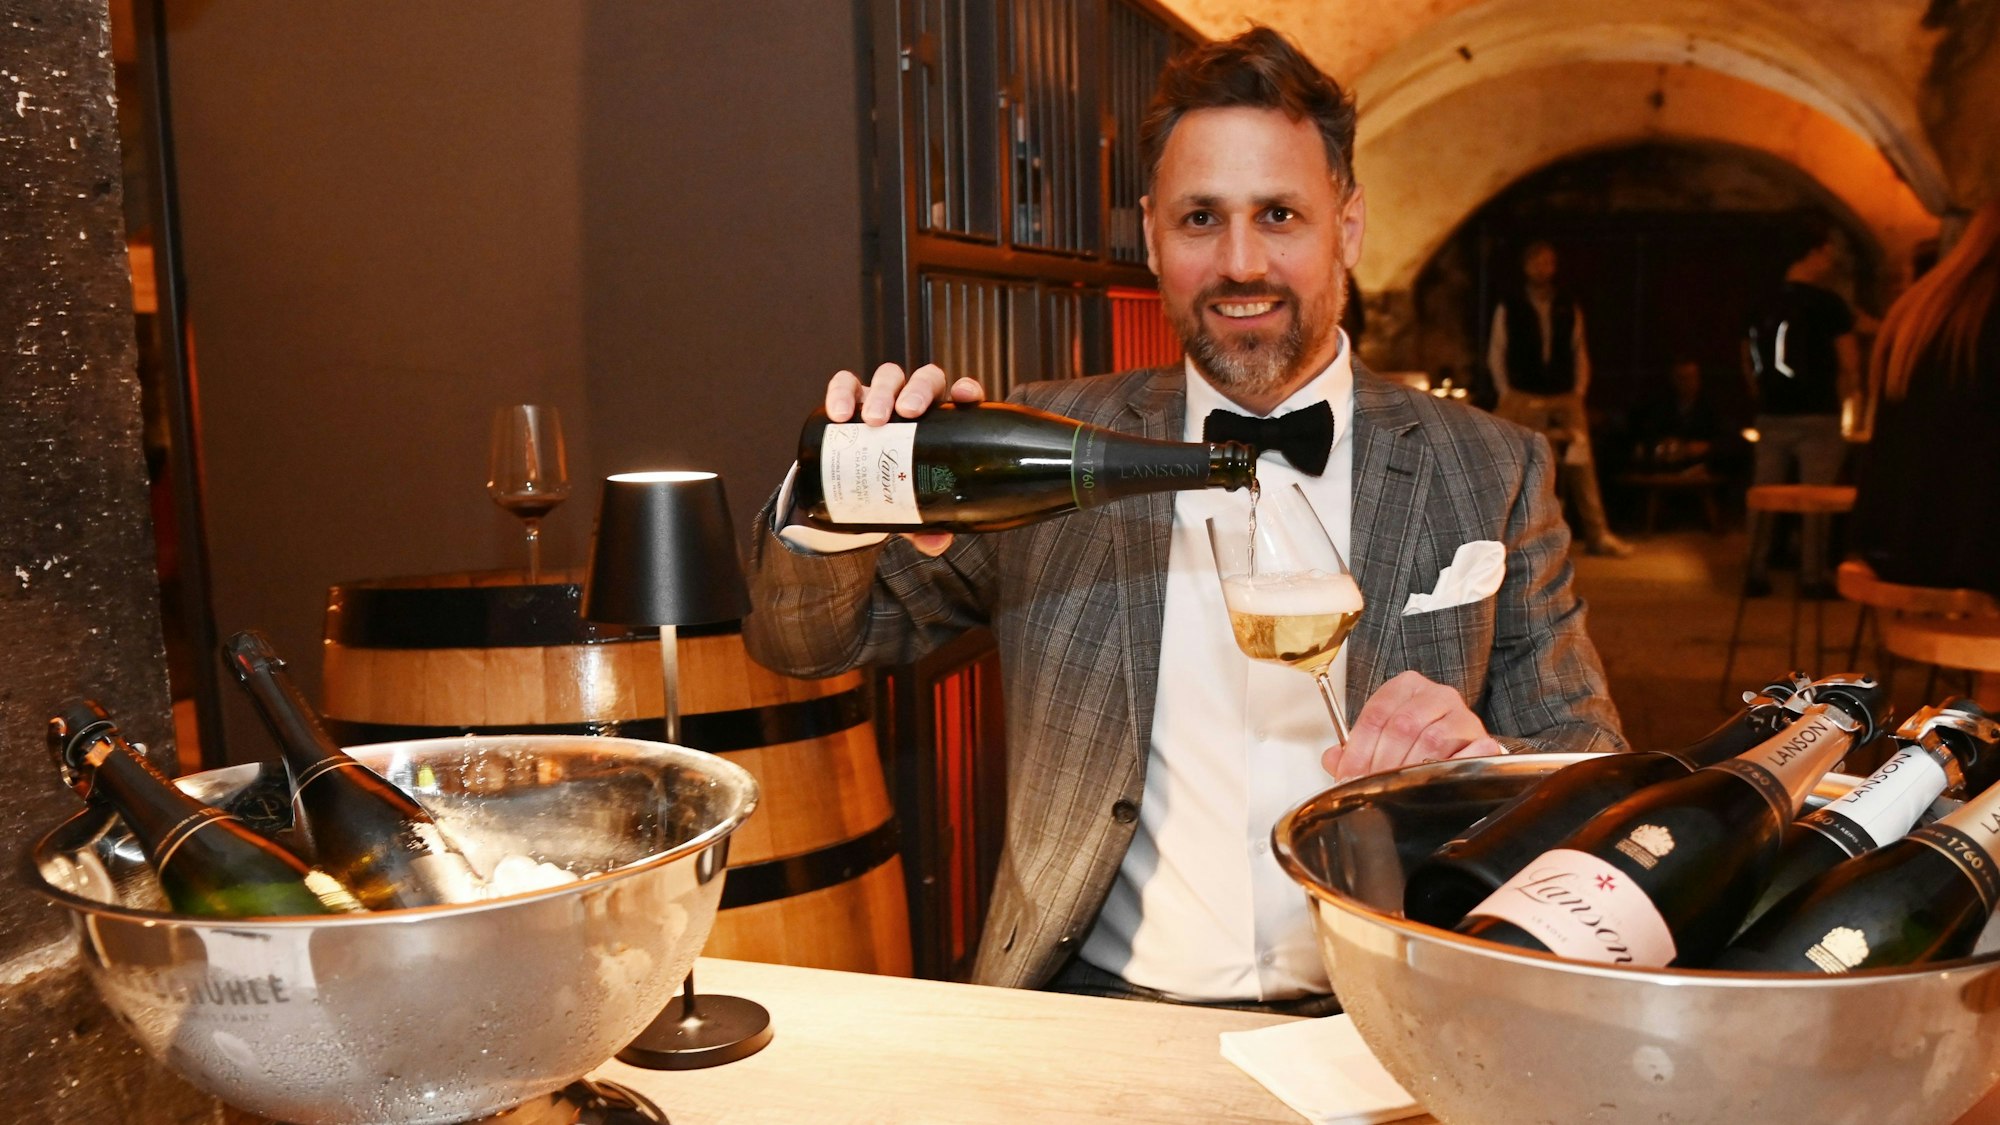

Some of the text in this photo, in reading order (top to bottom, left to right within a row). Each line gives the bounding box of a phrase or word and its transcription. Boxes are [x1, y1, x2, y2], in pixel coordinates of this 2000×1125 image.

[878, 446, 898, 504] Lanson
[1082, 460, 1095, 489] 1760
[1120, 463, 1200, 479] LANSON
[1767, 721, 1829, 767] LANSON
[1842, 753, 1912, 803] LANSON
[1946, 837, 1984, 869] 1760
[1512, 866, 1634, 964] Lanson
